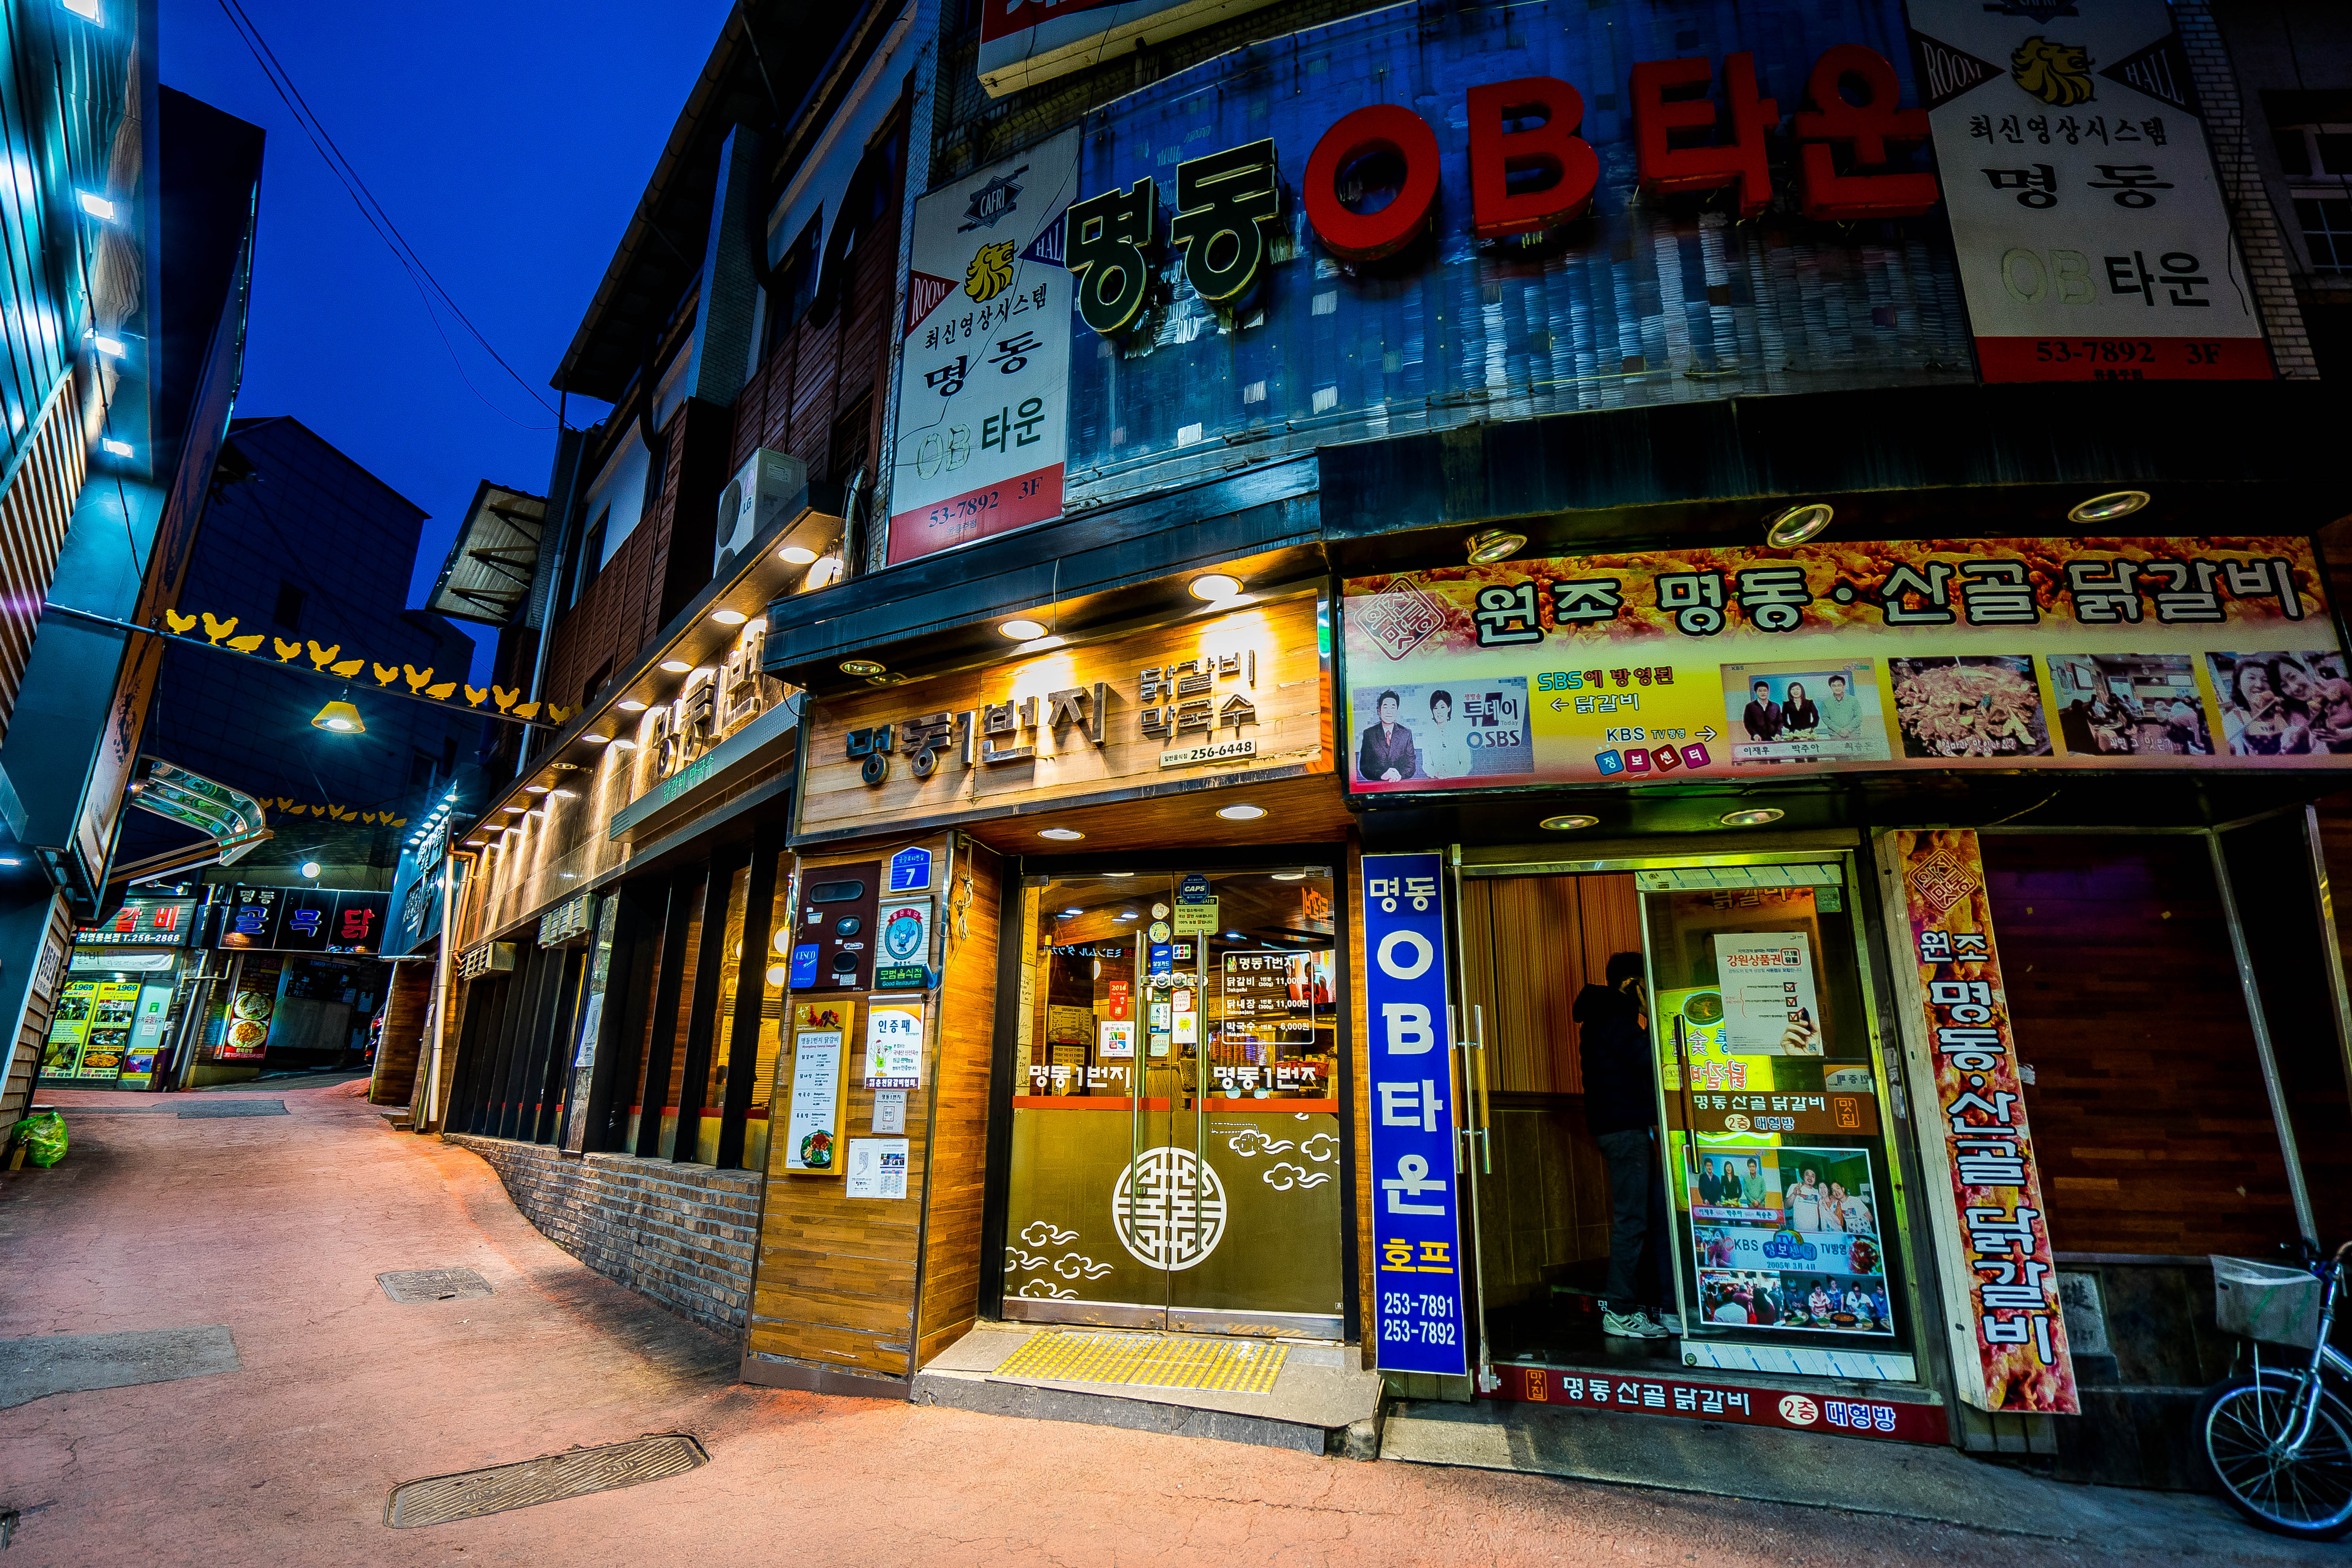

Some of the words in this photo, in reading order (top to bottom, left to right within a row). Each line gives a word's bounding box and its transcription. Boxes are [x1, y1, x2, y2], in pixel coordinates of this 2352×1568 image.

[1921, 41, 1982, 100] ROOM
[2125, 49, 2185, 105] HALL
[1968, 114, 2167, 147] 최신영상시스템
[1067, 138, 1278, 334] 명동
[1304, 44, 1938, 262] OB타운
[1980, 163, 2174, 209] 명동
[980, 186, 1005, 217] CAFRI
[1036, 216, 1067, 261] HAL
[911, 278, 946, 327] ROOM
[925, 283, 1047, 351] 최신영상시스템
[924, 330, 1043, 397] 명동
[2037, 342, 2155, 362] 53-7892
[2185, 343, 2221, 364] 3F
[743, 497, 751, 515] LG
[928, 491, 1000, 528] 53-7892
[1018, 476, 1044, 499] 3F
[1475, 579, 1624, 646] 원조
[2066, 560, 2302, 621] 닭갈비
[1140, 649, 1254, 700] 닭갈비
[1538, 670, 1604, 692] SBS에
[1611, 666, 1674, 687] 방영된
[1140, 694, 1254, 737] 막국수
[1462, 697, 1519, 726] 투데이
[1574, 693, 1640, 714] 닭갈비
[845, 681, 1109, 786] 명동1번지
[1485, 730, 1521, 748] SBS
[1606, 727, 1646, 743] KBS
[1651, 730, 1666, 739] TV
[1668, 728, 1686, 739] 방영
[1164, 753, 1188, 762] 일반음식점
[1190, 741, 1252, 760] 256-6448
[689, 753, 715, 784] 막국수
[906, 868, 915, 885] 7
[1370, 877, 1436, 913] 명동
[76, 933, 121, 942] 천명동본점
[122, 934, 180, 942] T.256-2868
[1921, 931, 1989, 963] 원조
[796, 951, 815, 960] CESCO
[1174, 946, 1189, 957] JCB
[1239, 957, 1296, 970] 명동1번지
[1726, 954, 1782, 967] 강원상품권
[880, 967, 922, 980] 모범음식점
[1227, 976, 1254, 986] 닭갈비
[1227, 999, 1255, 1009] 닭내장
[1276, 999, 1309, 1009] 11,000원
[878, 1019, 910, 1033] 인증패
[1226, 1022, 1255, 1031] 막국수
[1280, 1022, 1310, 1032] 6,000원
[1028, 1065, 1131, 1089] 명동1번지
[1693, 1095, 1727, 1111] 명동
[1731, 1095, 1766, 1112] 산골
[1771, 1096, 1825, 1112] 닭갈비
[1728, 1116, 1749, 1129] 2층
[1754, 1116, 1795, 1131] 대형방
[1381, 1238, 1454, 1274] 호프
[1733, 1238, 1759, 1251] KBS
[1966, 1206, 2055, 1365] 닭갈비
[1384, 1292, 1454, 1318] 253-7891
[1383, 1318, 1456, 1345] 253-7892
[1563, 1376, 1612, 1403] 명동
[1616, 1381, 1666, 1408] 산골
[1672, 1386, 1751, 1416] 닭갈비
[1783, 1399, 1818, 1421] 2층
[1825, 1400, 1896, 1432] 대형방
